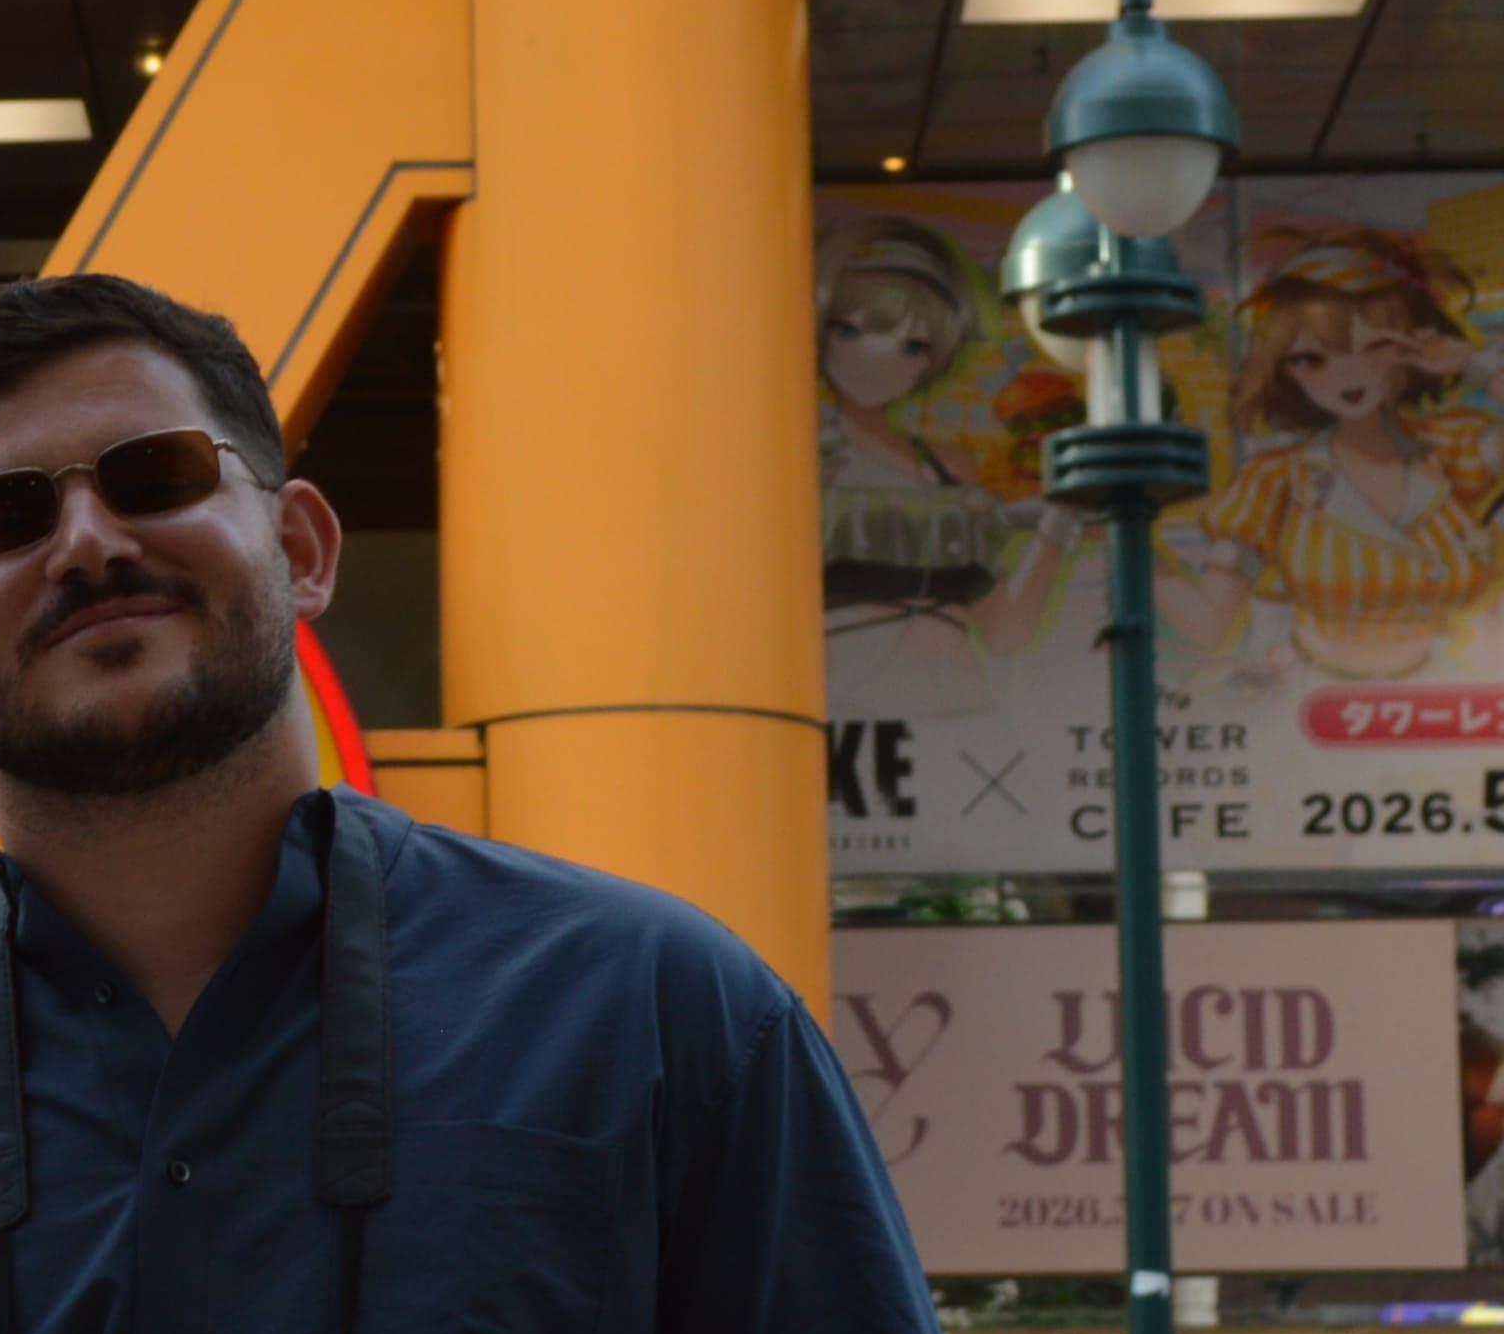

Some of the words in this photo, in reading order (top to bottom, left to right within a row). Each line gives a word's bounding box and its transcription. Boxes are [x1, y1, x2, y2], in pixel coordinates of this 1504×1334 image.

[1068, 766, 1250, 789] REORDS
[1070, 803, 1251, 841] CFE
[1202, 1192, 1263, 1225] ON
[1271, 1190, 1381, 1226] SALE
